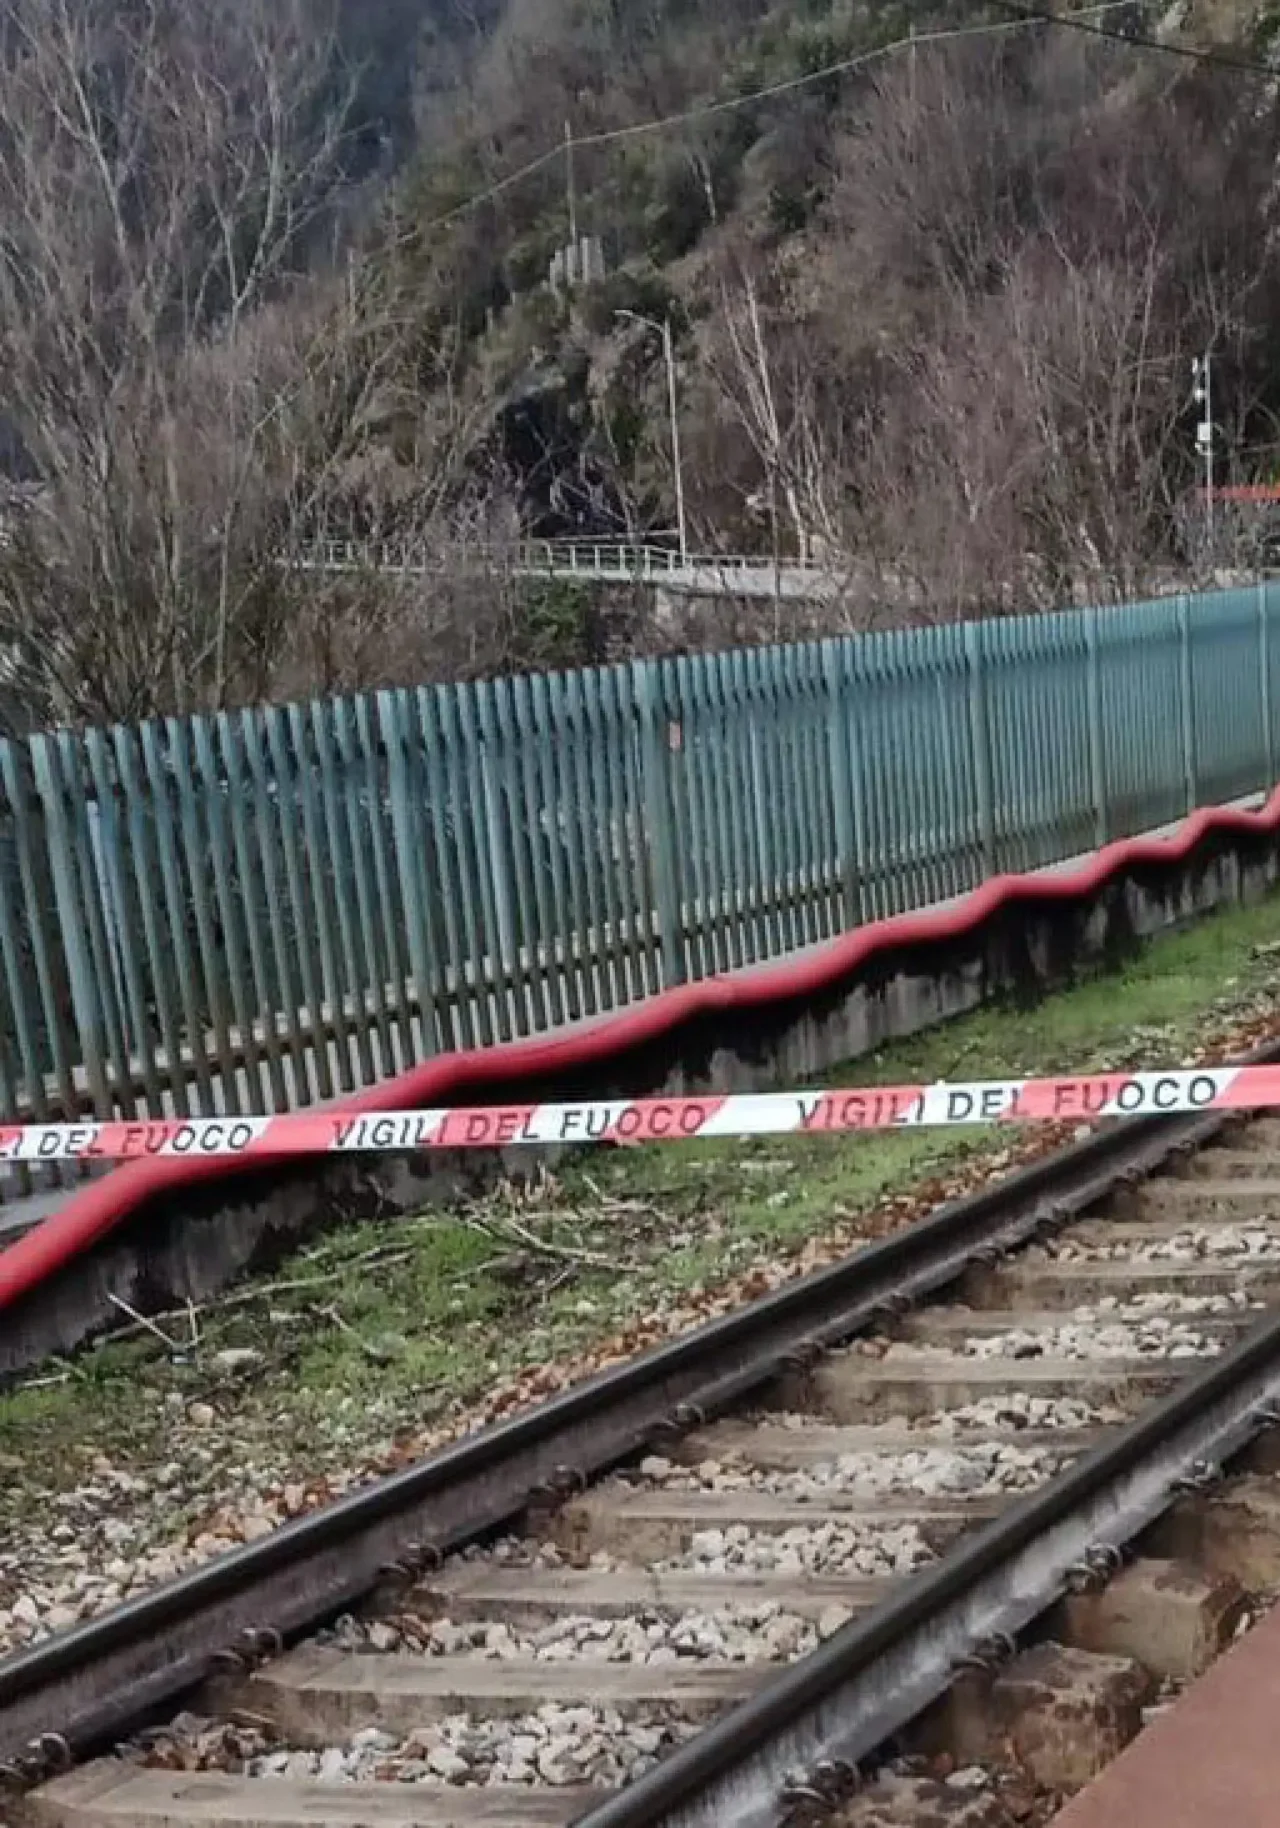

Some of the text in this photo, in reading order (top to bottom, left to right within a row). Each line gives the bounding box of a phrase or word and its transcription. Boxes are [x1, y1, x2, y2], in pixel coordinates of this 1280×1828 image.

[796, 1075, 1218, 1128] VIGILI DEL FUOCO
[37, 1128, 103, 1157] DEL
[121, 1122, 253, 1155] FUOCO
[331, 1103, 706, 1148] VIGILI DEL FUOCO
